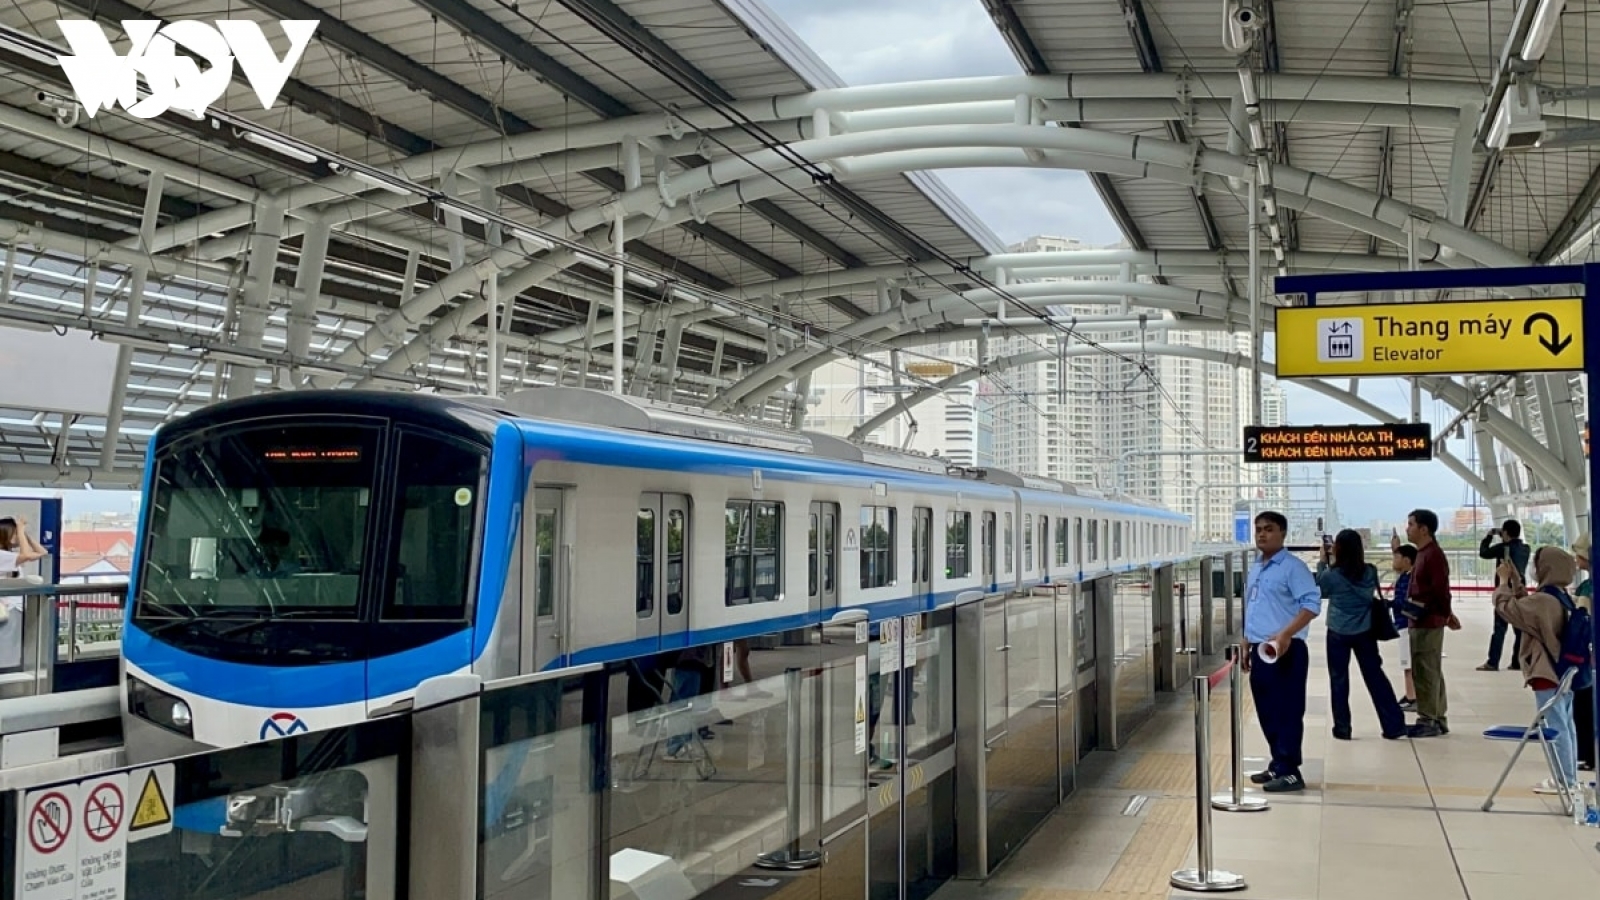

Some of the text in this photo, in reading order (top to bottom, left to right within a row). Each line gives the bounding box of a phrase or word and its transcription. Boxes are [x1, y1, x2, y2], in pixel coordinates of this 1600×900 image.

[1373, 313, 1512, 341] Thang máy
[1373, 346, 1444, 361] Elevator
[1378, 431, 1393, 442] TH
[1247, 437, 1257, 452] 2
[1359, 446, 1376, 456] GA
[1378, 446, 1394, 456] TH
